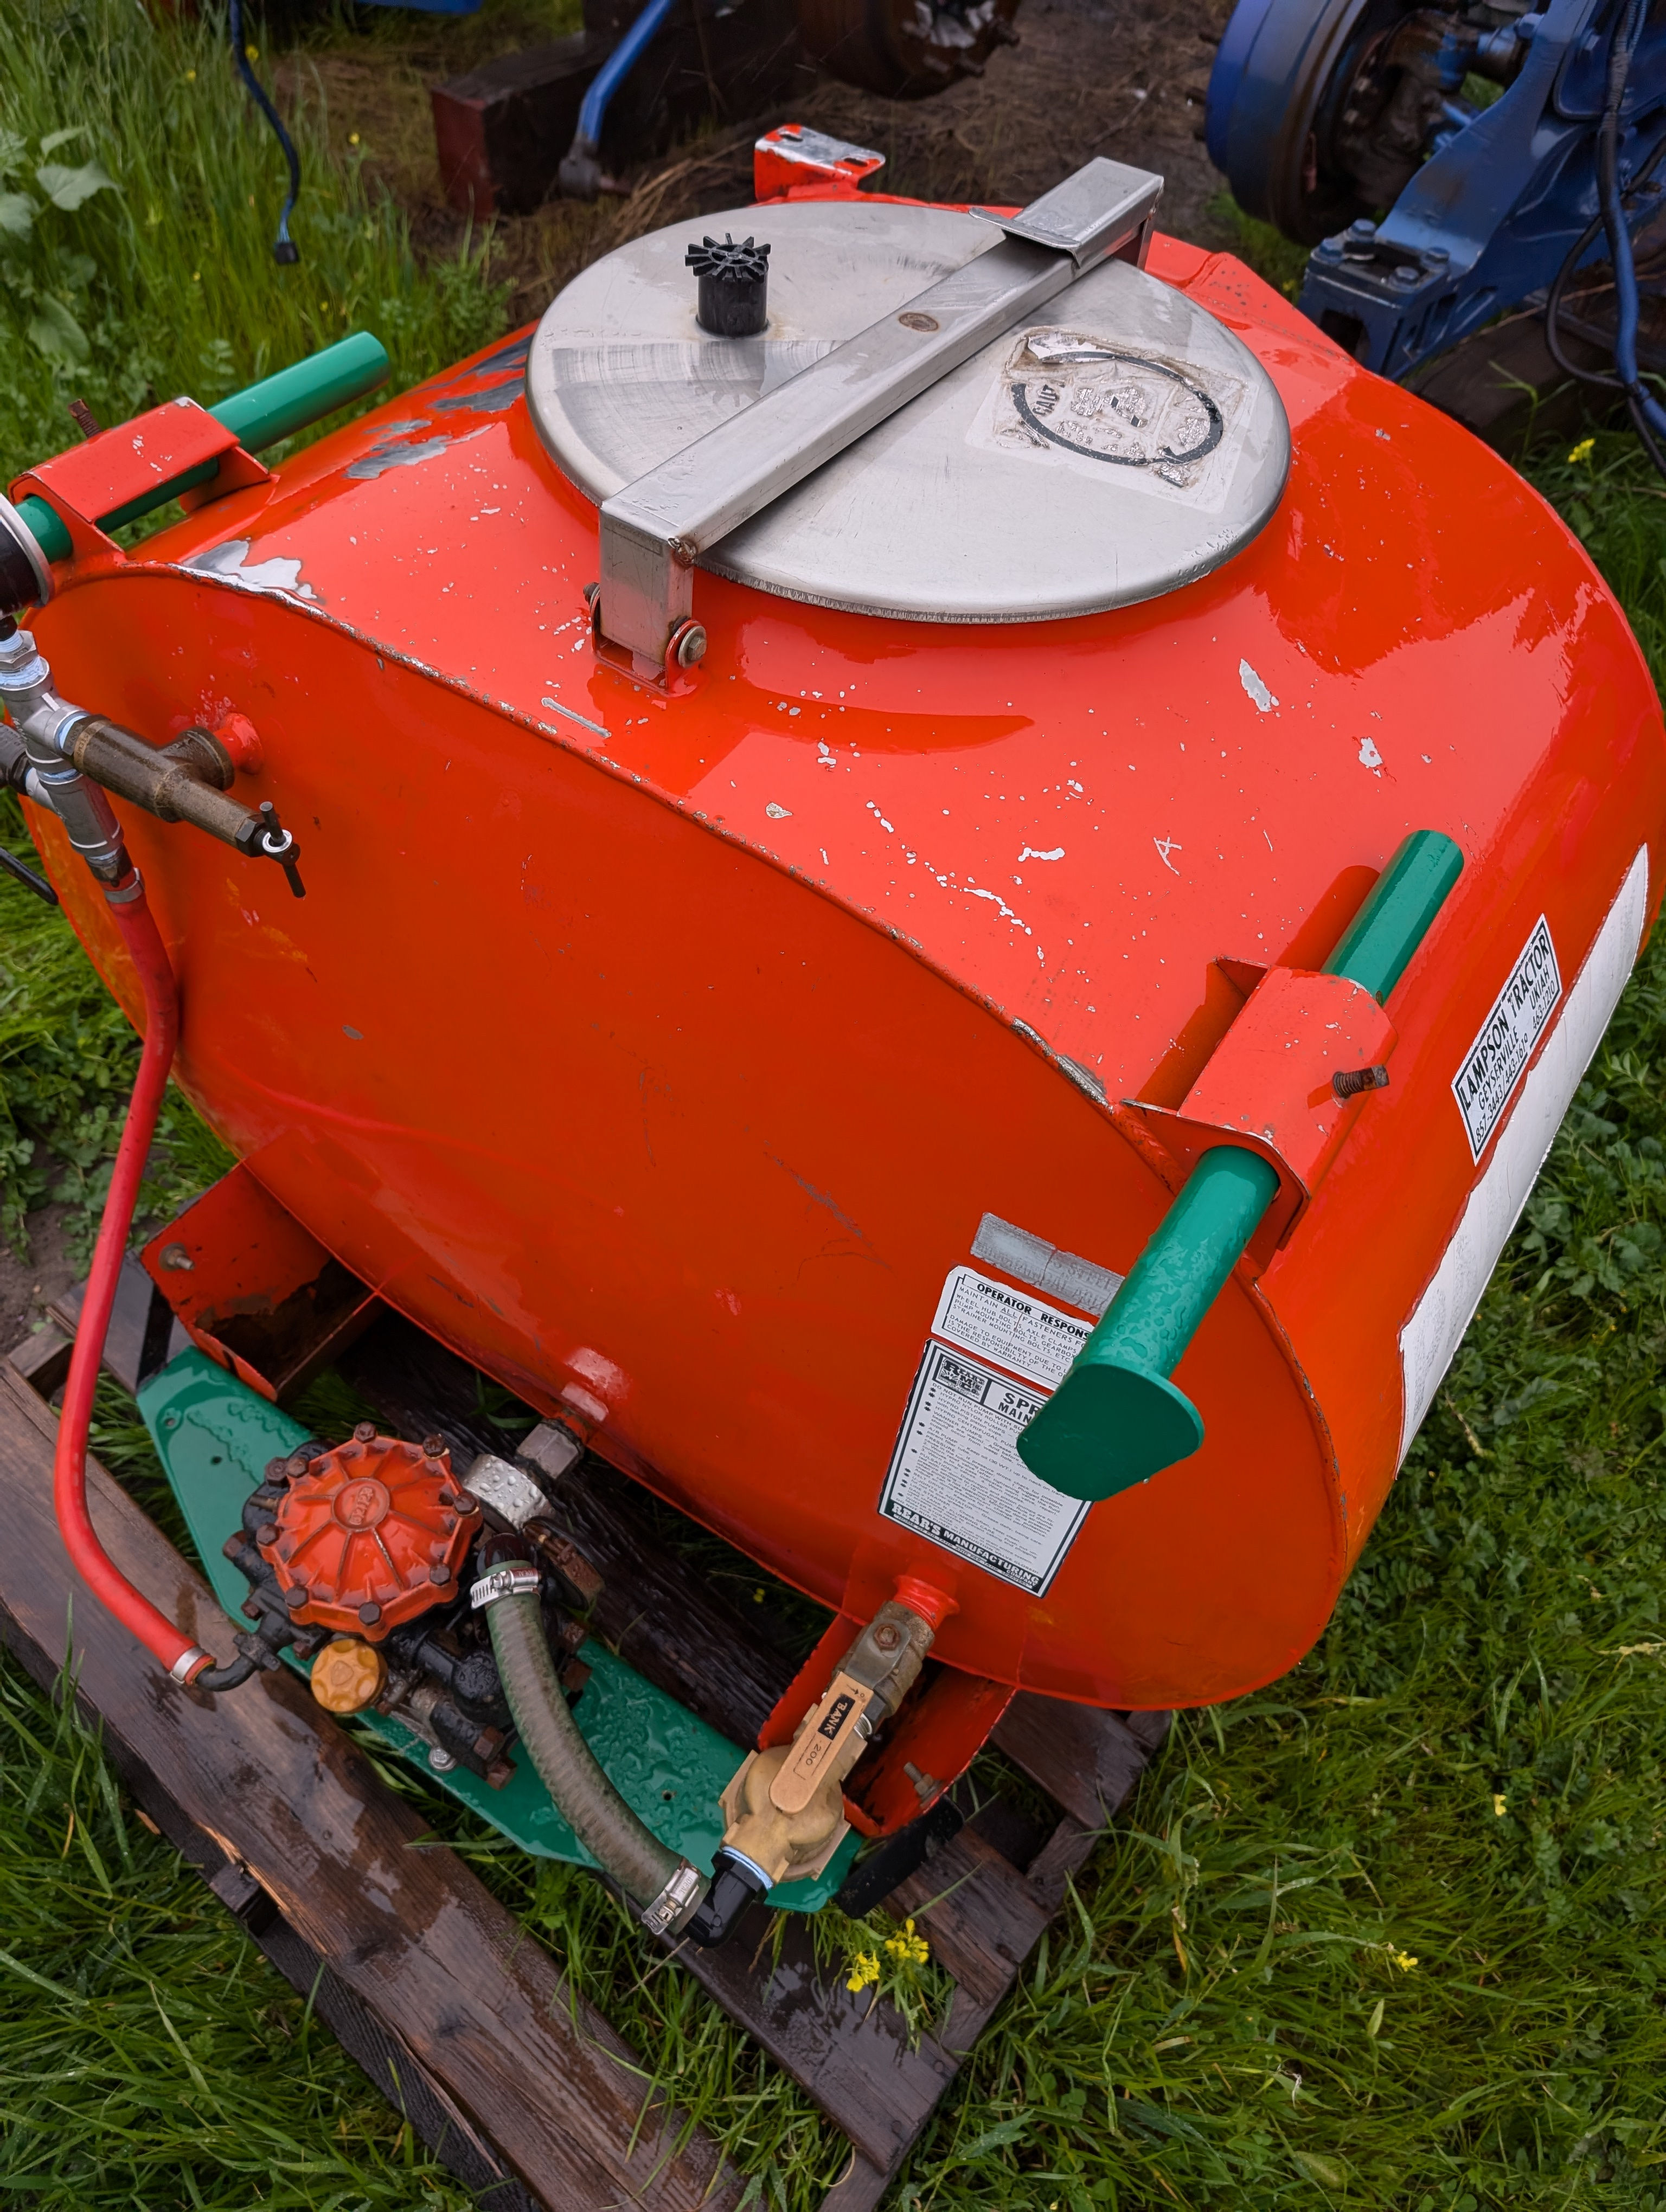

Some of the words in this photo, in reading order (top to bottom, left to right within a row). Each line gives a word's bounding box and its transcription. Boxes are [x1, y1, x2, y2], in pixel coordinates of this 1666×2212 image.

[1529, 964, 1549, 1009] UKIAH
[1533, 980, 1555, 1029] 463-1210
[1460, 1009, 1509, 1110] LAMPSON
[1507, 935, 1548, 1017] TRACTOR
[1478, 1026, 1518, 1110] GEYSERVILLE
[954, 1298, 973, 1309] PUMP
[975, 1310, 1011, 1329] MOUNTING
[957, 1293, 979, 1308] WHEEL
[981, 1306, 996, 1316] HUB
[998, 1314, 1023, 1330] BOLTS,
[1026, 1328, 1046, 1340] AXLE
[959, 1286, 998, 1308] MAINTAIN
[1001, 1307, 1017, 1318] ALL
[1022, 1316, 1072, 1342] FASTENERS
[977, 1283, 1031, 1314] OPERATOR
[947, 1324, 979, 1342] COVERED
[994, 1347, 1032, 1368] WARRANTY.
[950, 1314, 978, 1331] DAMAGE
[991, 1335, 1032, 1356] EQUIPMENT
[1034, 1355, 1049, 1365] DUE
[953, 1304, 986, 1323] STRAINER
[989, 1322, 1024, 1342] MOUNTING
[1055, 1353, 1073, 1363] ETC.
[957, 1323, 970, 1333] THE
[1042, 1364, 1055, 1373] THE
[935, 1406, 956, 1418] HYPRO
[957, 1418, 998, 1441] CENTRIFUGAL
[937, 1401, 949, 1409] with
[950, 1407, 969, 1420] leaking
[970, 1419, 986, 1429] piston
[988, 1428, 1002, 1437] cups.
[938, 1397, 959, 1410] HYPRO
[960, 1408, 982, 1422] PISTON
[984, 1420, 1005, 1433] PUMPS
[940, 1392, 960, 1404] HYPRO
[962, 1403, 983, 1416] NYLON
[984, 1414, 1008, 1429] ROLLER
[943, 1388, 957, 1397] NOT
[958, 1396, 972, 1405] RUN
[973, 1404, 993, 1416] PUMP
[995, 1414, 1011, 1426] WITH
[998, 1402, 1031, 1424] MAIN
[926, 1435, 955, 1452] PRESSURE
[931, 1418, 948, 1429] should
[950, 1429, 965, 1438] occur
[968, 1438, 981, 1446] from
[932, 1414, 954, 1428] bearings
[1002, 1450, 1019, 1461] before
[933, 1411, 959, 1426] WANNER
[960, 1425, 982, 1438] PUMPS
[993, 1442, 1011, 1453] Grease
[892, 1503, 940, 1535] REAR'S
[944, 1531, 1039, 1584] MANUFACTURING
[1006, 1570, 1036, 1586] COMPANY
[824, 1702, 848, 1733] BANK
[806, 1744, 822, 1765] 200
